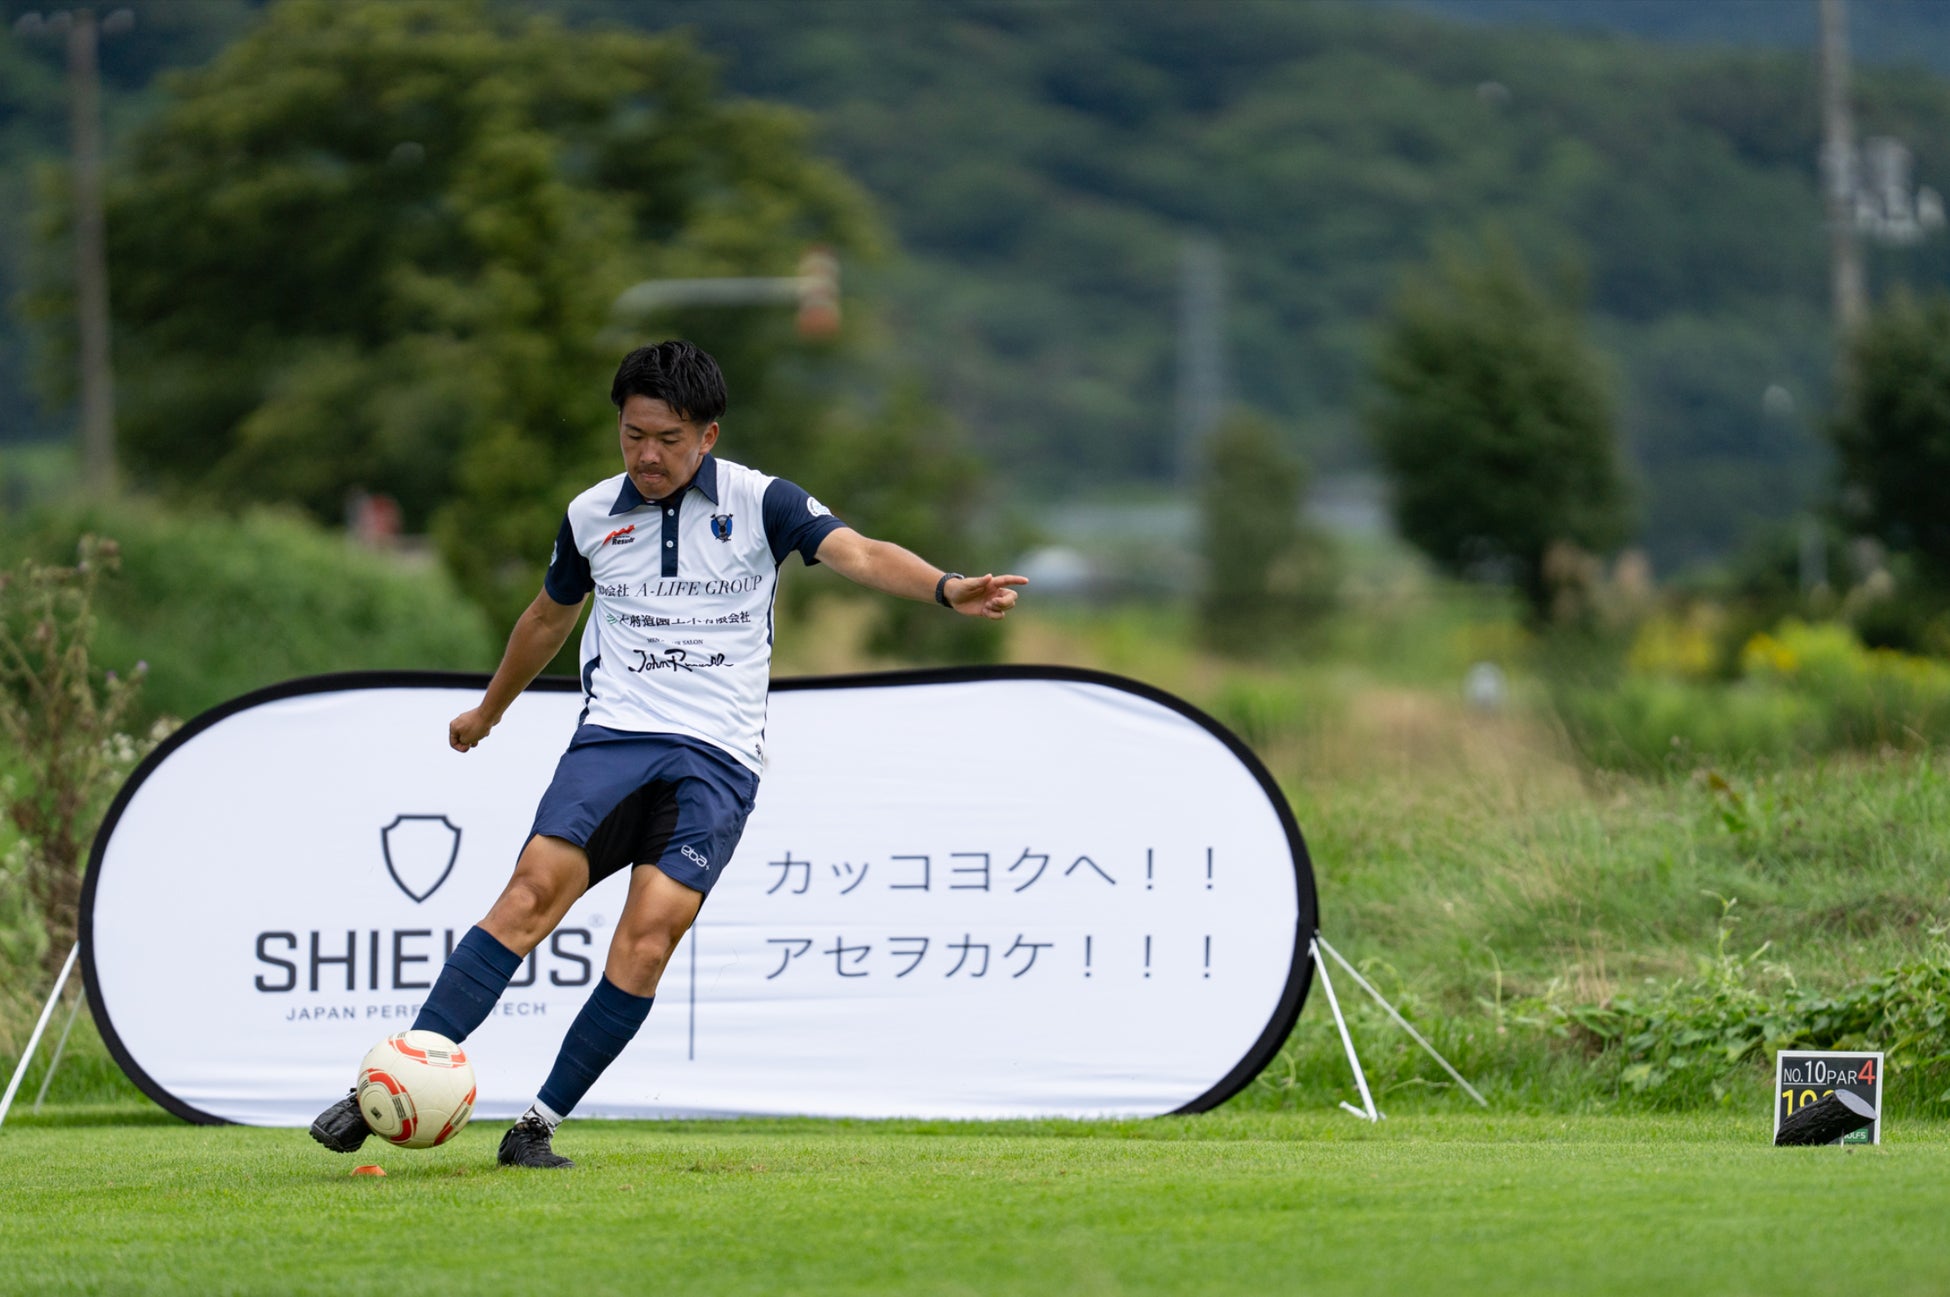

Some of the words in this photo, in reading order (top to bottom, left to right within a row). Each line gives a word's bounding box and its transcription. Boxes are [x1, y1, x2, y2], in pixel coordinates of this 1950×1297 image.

[636, 580, 700, 598] A-LIFE
[705, 574, 762, 595] GROUP
[765, 933, 1213, 979] アセヲカケ！！！
[286, 1007, 356, 1021] JAPAN
